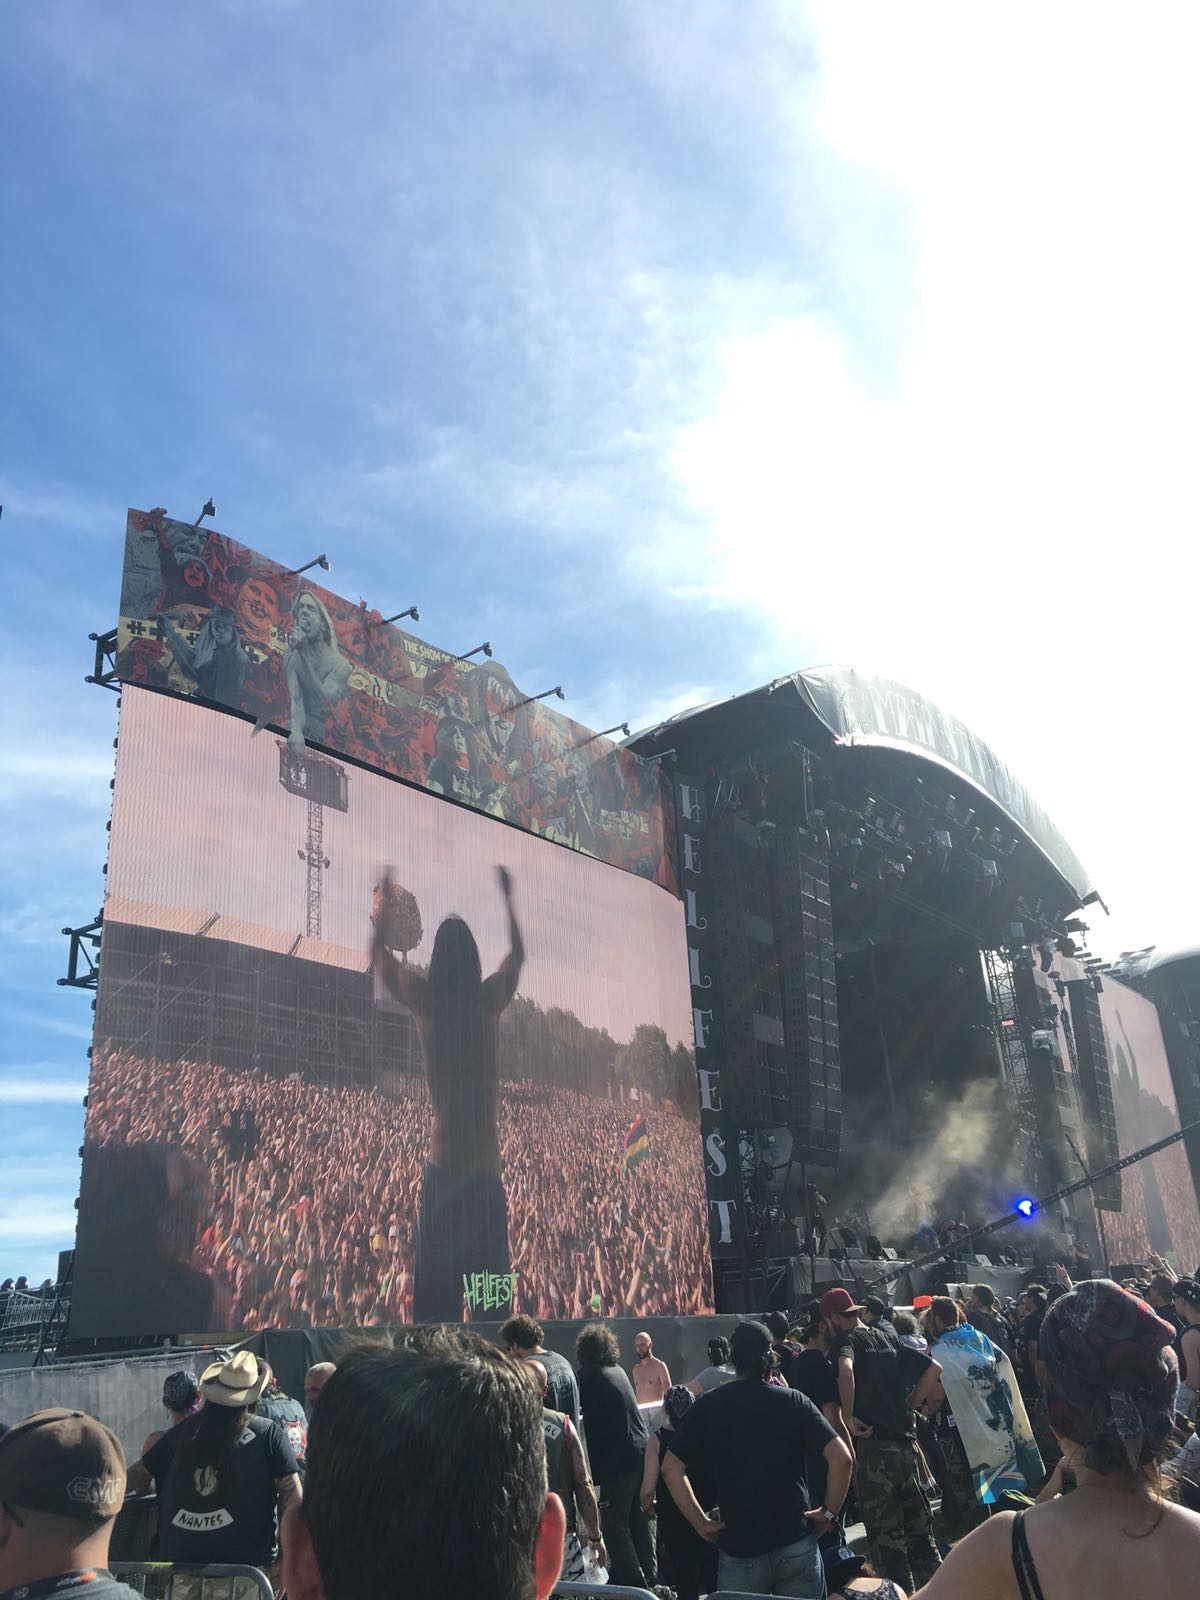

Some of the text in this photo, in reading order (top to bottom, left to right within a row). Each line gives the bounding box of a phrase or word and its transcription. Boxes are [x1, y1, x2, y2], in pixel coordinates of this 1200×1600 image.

[403, 639, 419, 655] THE
[463, 1269, 520, 1312] HELLFEST
[178, 1513, 224, 1528] NANTES
